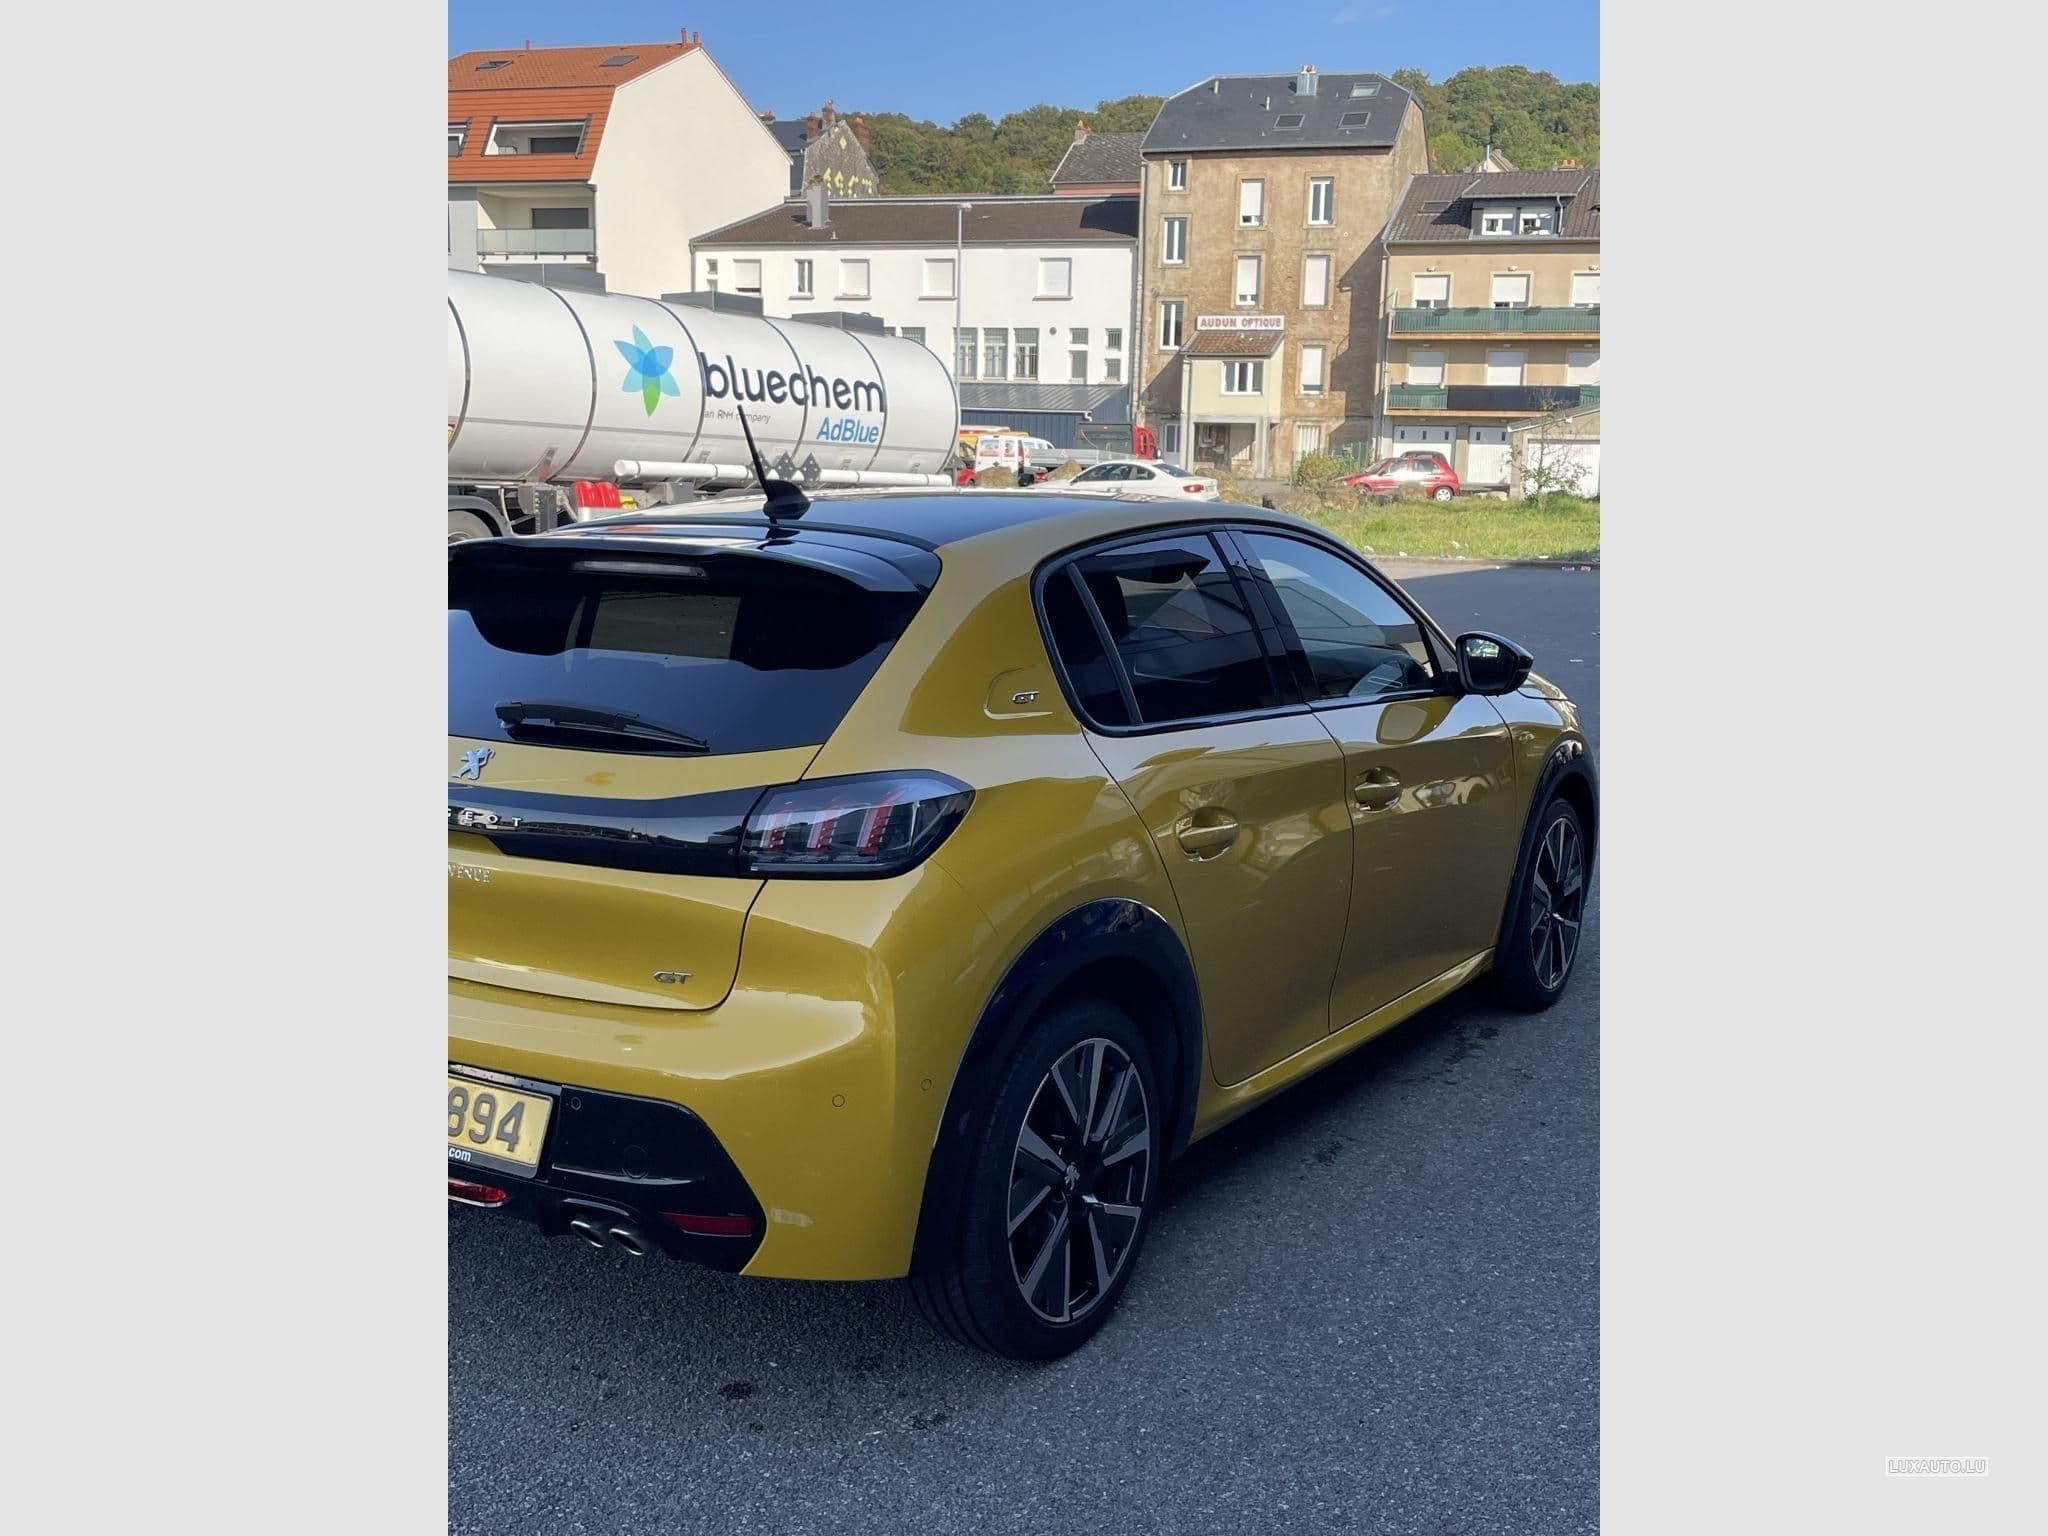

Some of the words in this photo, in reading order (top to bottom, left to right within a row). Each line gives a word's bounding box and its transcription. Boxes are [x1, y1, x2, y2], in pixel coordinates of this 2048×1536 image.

[1200, 318, 1237, 328] AUDUN
[1241, 318, 1281, 329] OPTIQUE
[699, 352, 887, 413] bluechem
[736, 412, 771, 424] cmpany
[816, 417, 880, 443] AdBlue
[1011, 690, 1039, 704] GT
[653, 970, 693, 984] GT
[448, 1086, 525, 1152] 894
